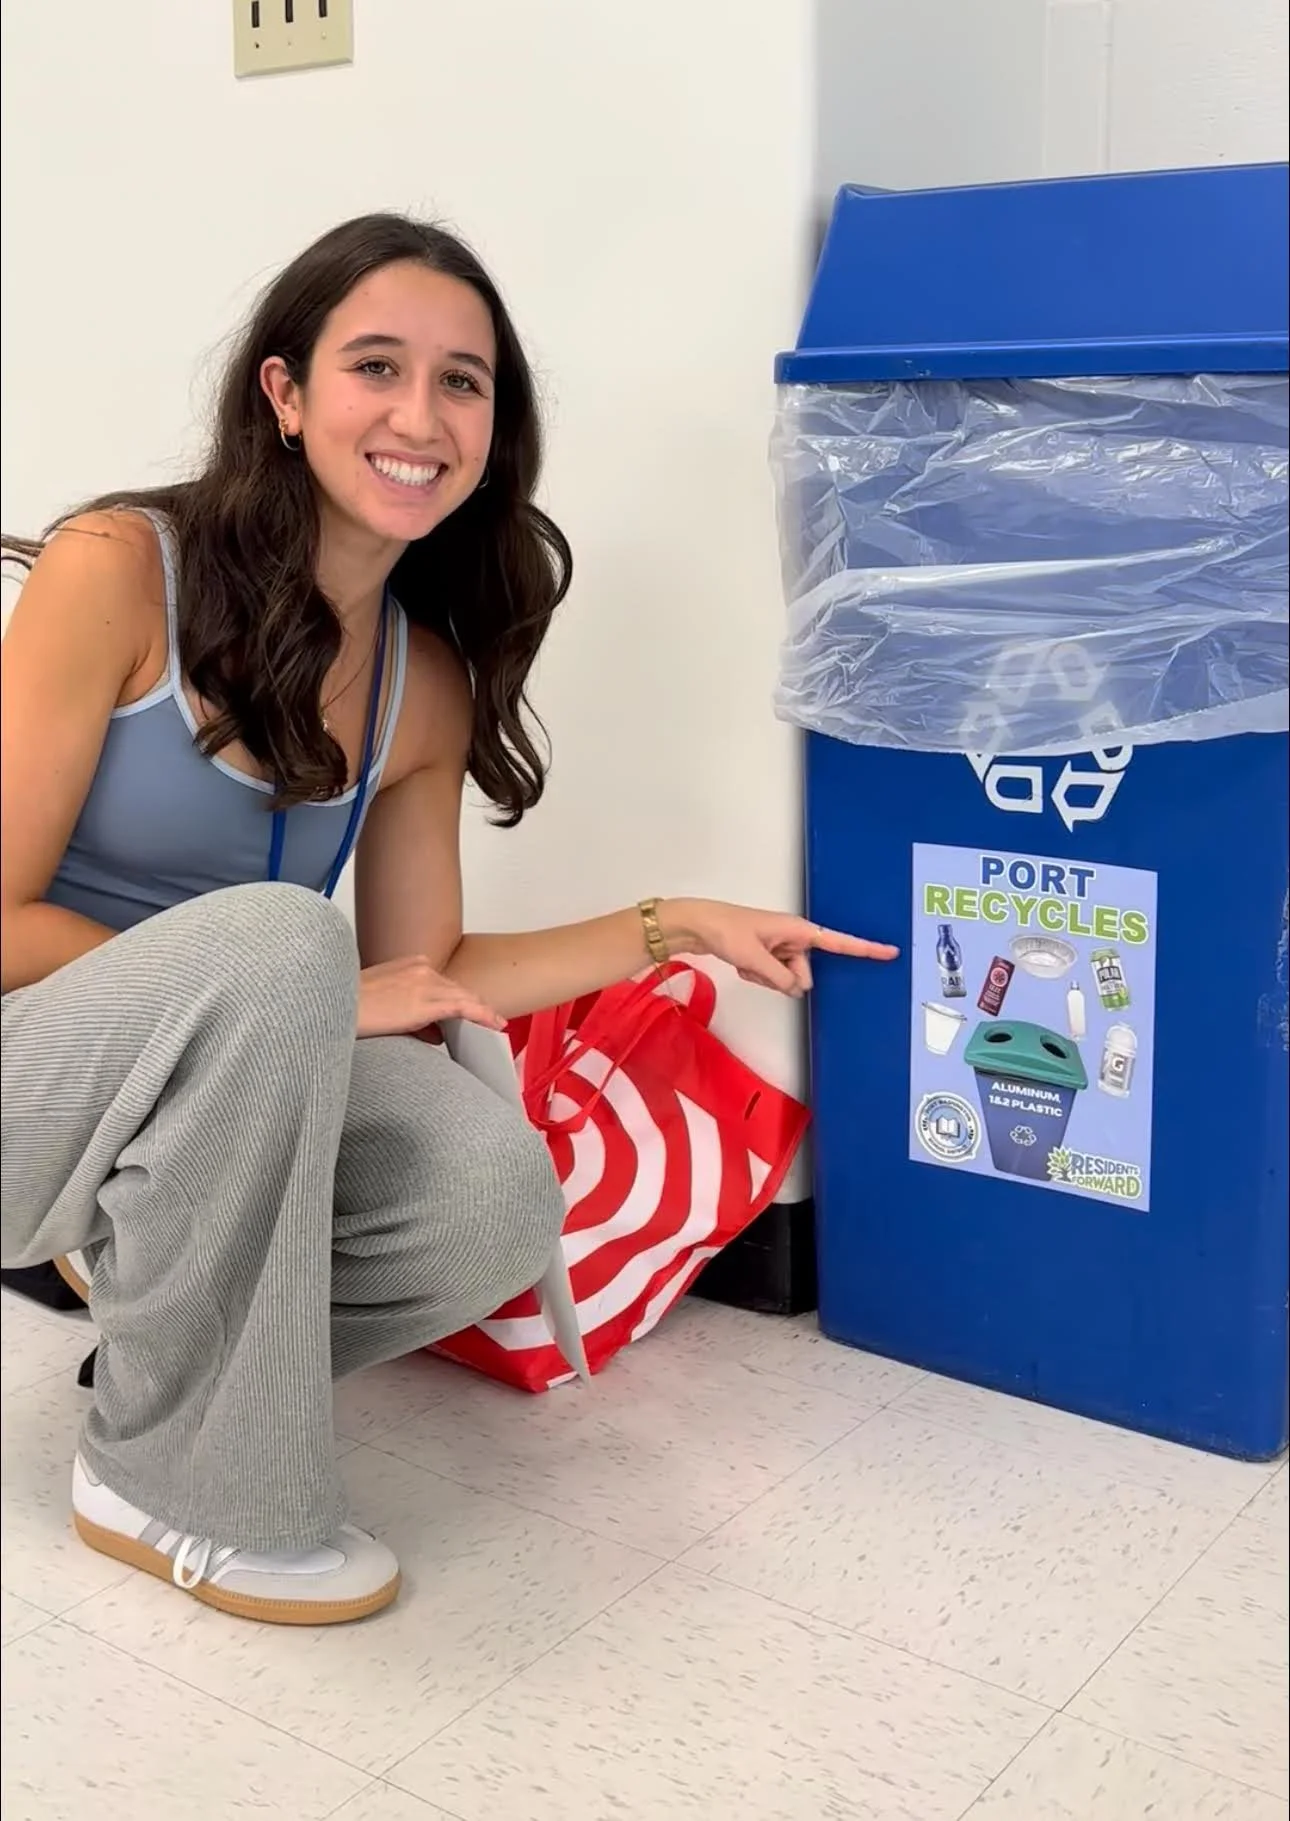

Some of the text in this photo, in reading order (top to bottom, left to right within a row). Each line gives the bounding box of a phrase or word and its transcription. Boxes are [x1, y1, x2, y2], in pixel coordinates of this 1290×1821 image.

[981, 855, 1096, 899] PORT
[924, 884, 1148, 944] RECYCLES
[988, 1094, 1063, 1117] 1&2 PLASTIC
[1070, 1174, 1140, 1197] FORWARD
